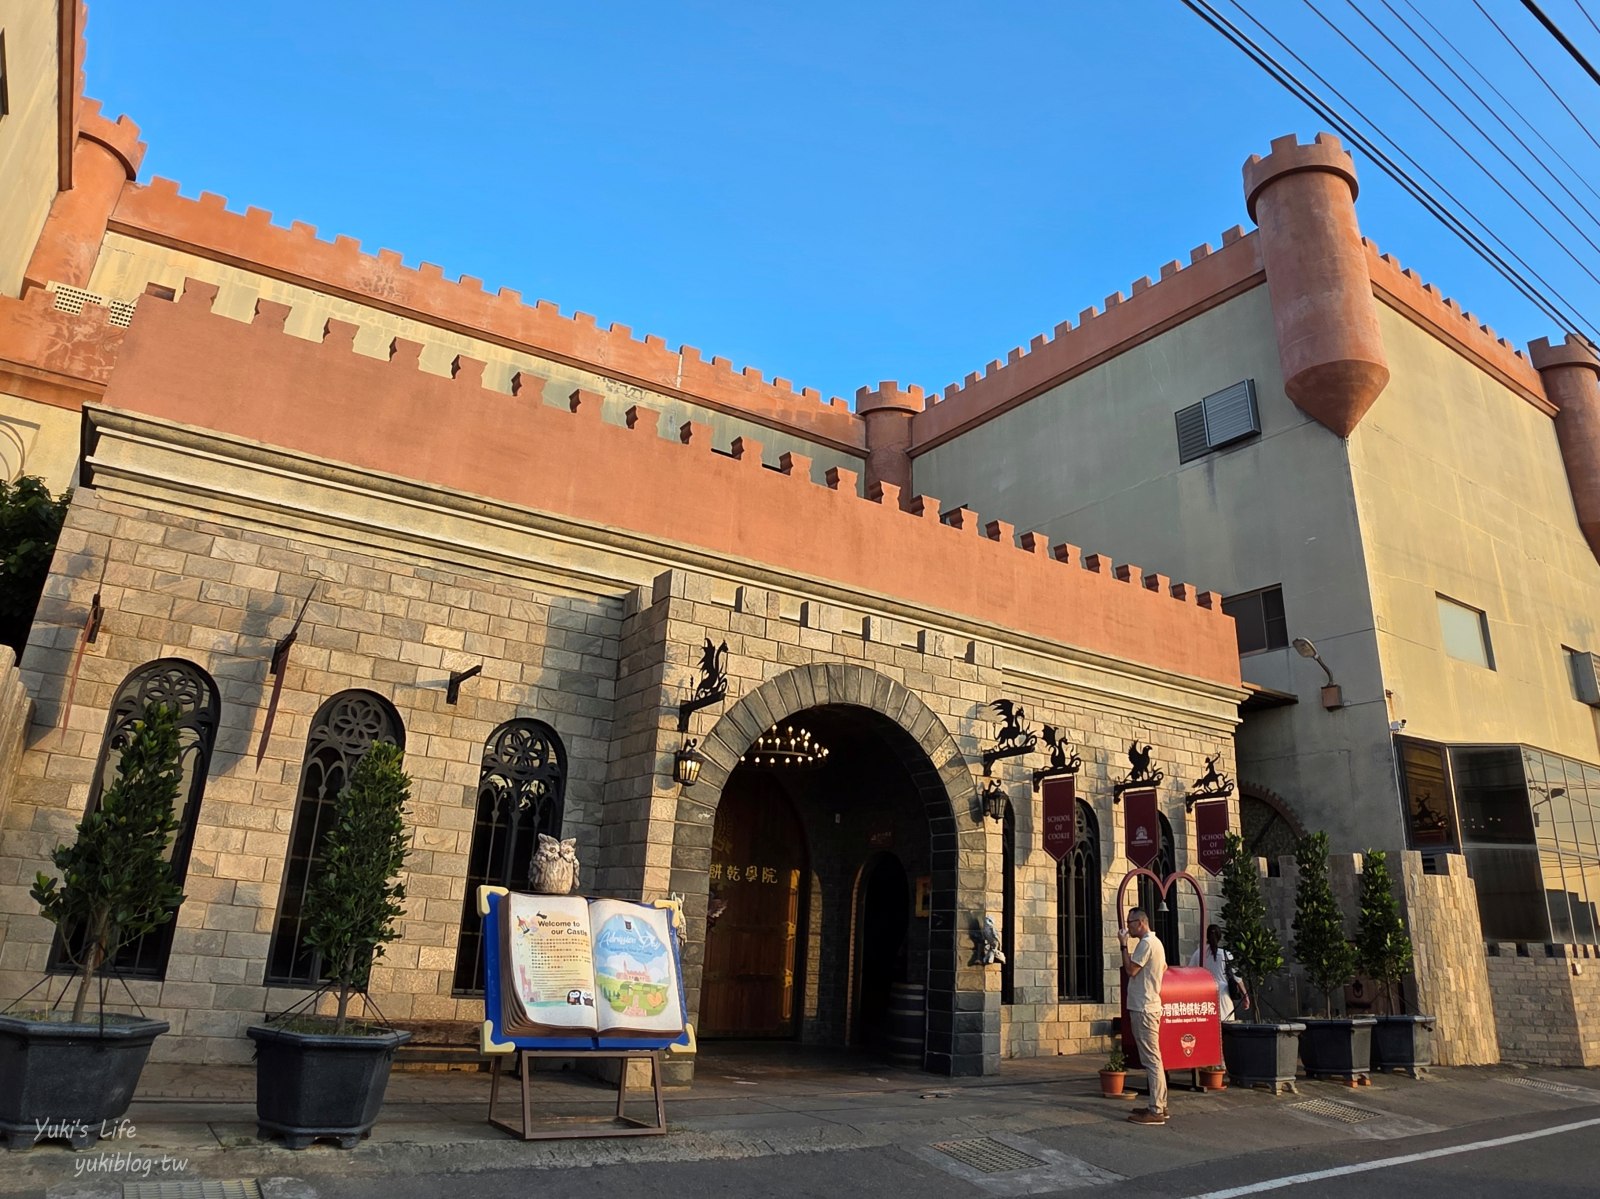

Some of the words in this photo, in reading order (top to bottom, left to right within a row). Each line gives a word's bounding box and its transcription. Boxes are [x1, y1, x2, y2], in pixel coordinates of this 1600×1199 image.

[1047, 814, 1071, 823] SCHOOL
[1054, 823, 1063, 831] OF
[1047, 832, 1070, 840] COOKIE
[537, 920, 571, 928] Welcome
